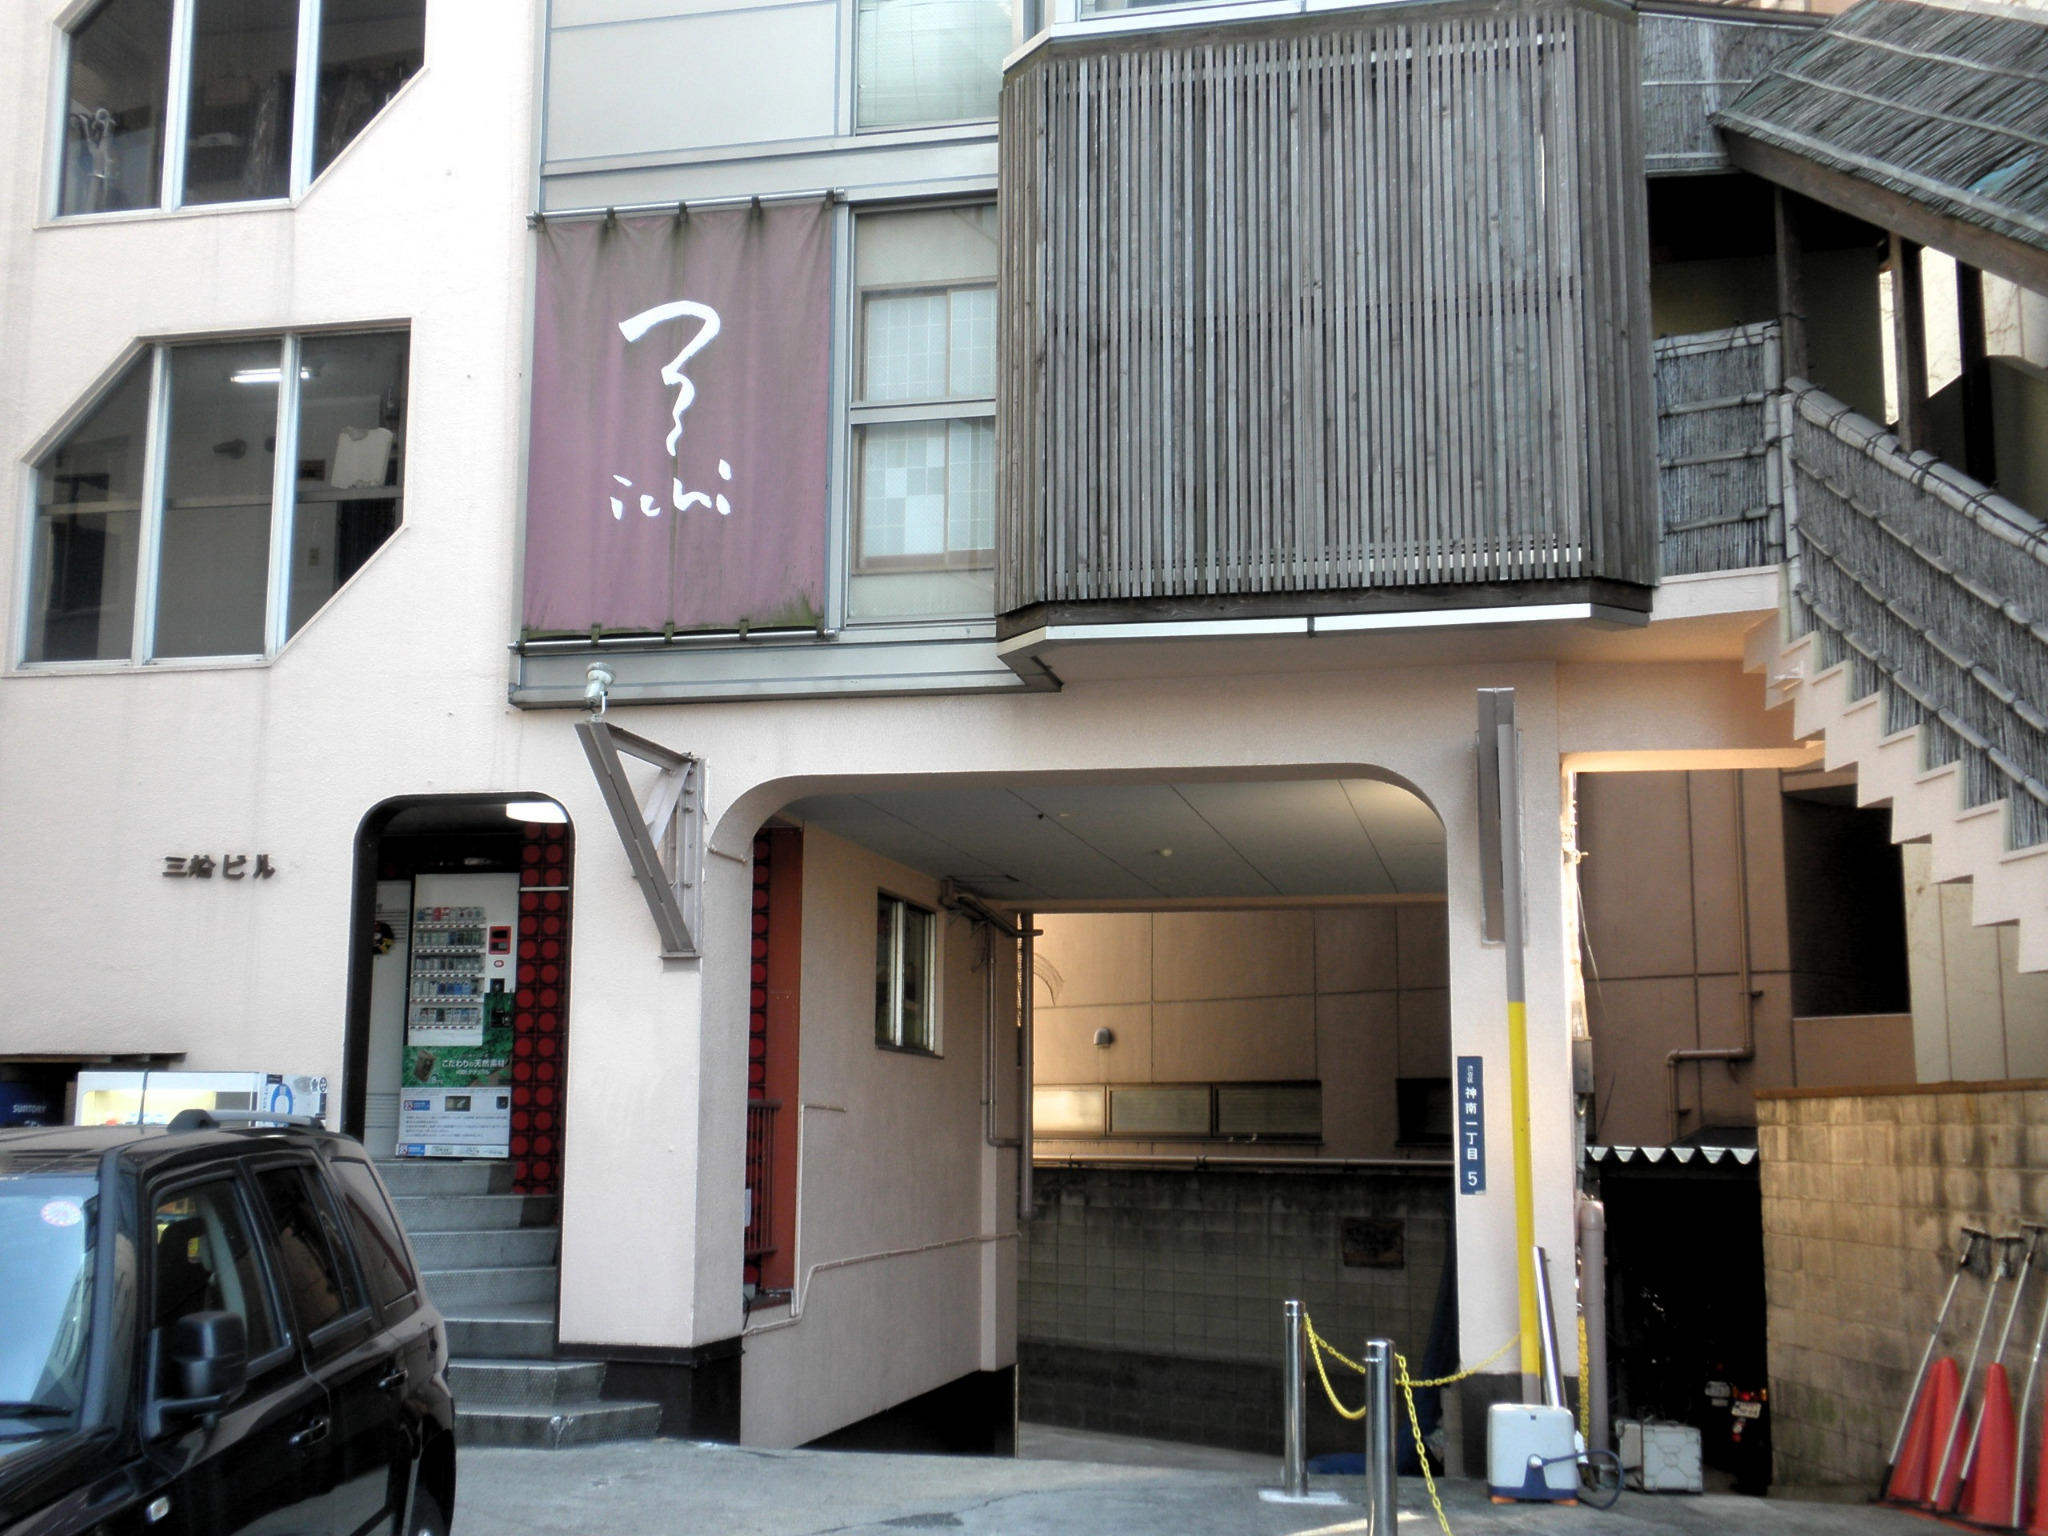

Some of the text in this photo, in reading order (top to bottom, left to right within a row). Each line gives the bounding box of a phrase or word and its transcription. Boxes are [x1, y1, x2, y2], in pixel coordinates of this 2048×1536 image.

[609, 458, 732, 521] ichi
[1465, 1087, 1478, 1160] 神南一丁目
[1467, 1171, 1478, 1186] 5
